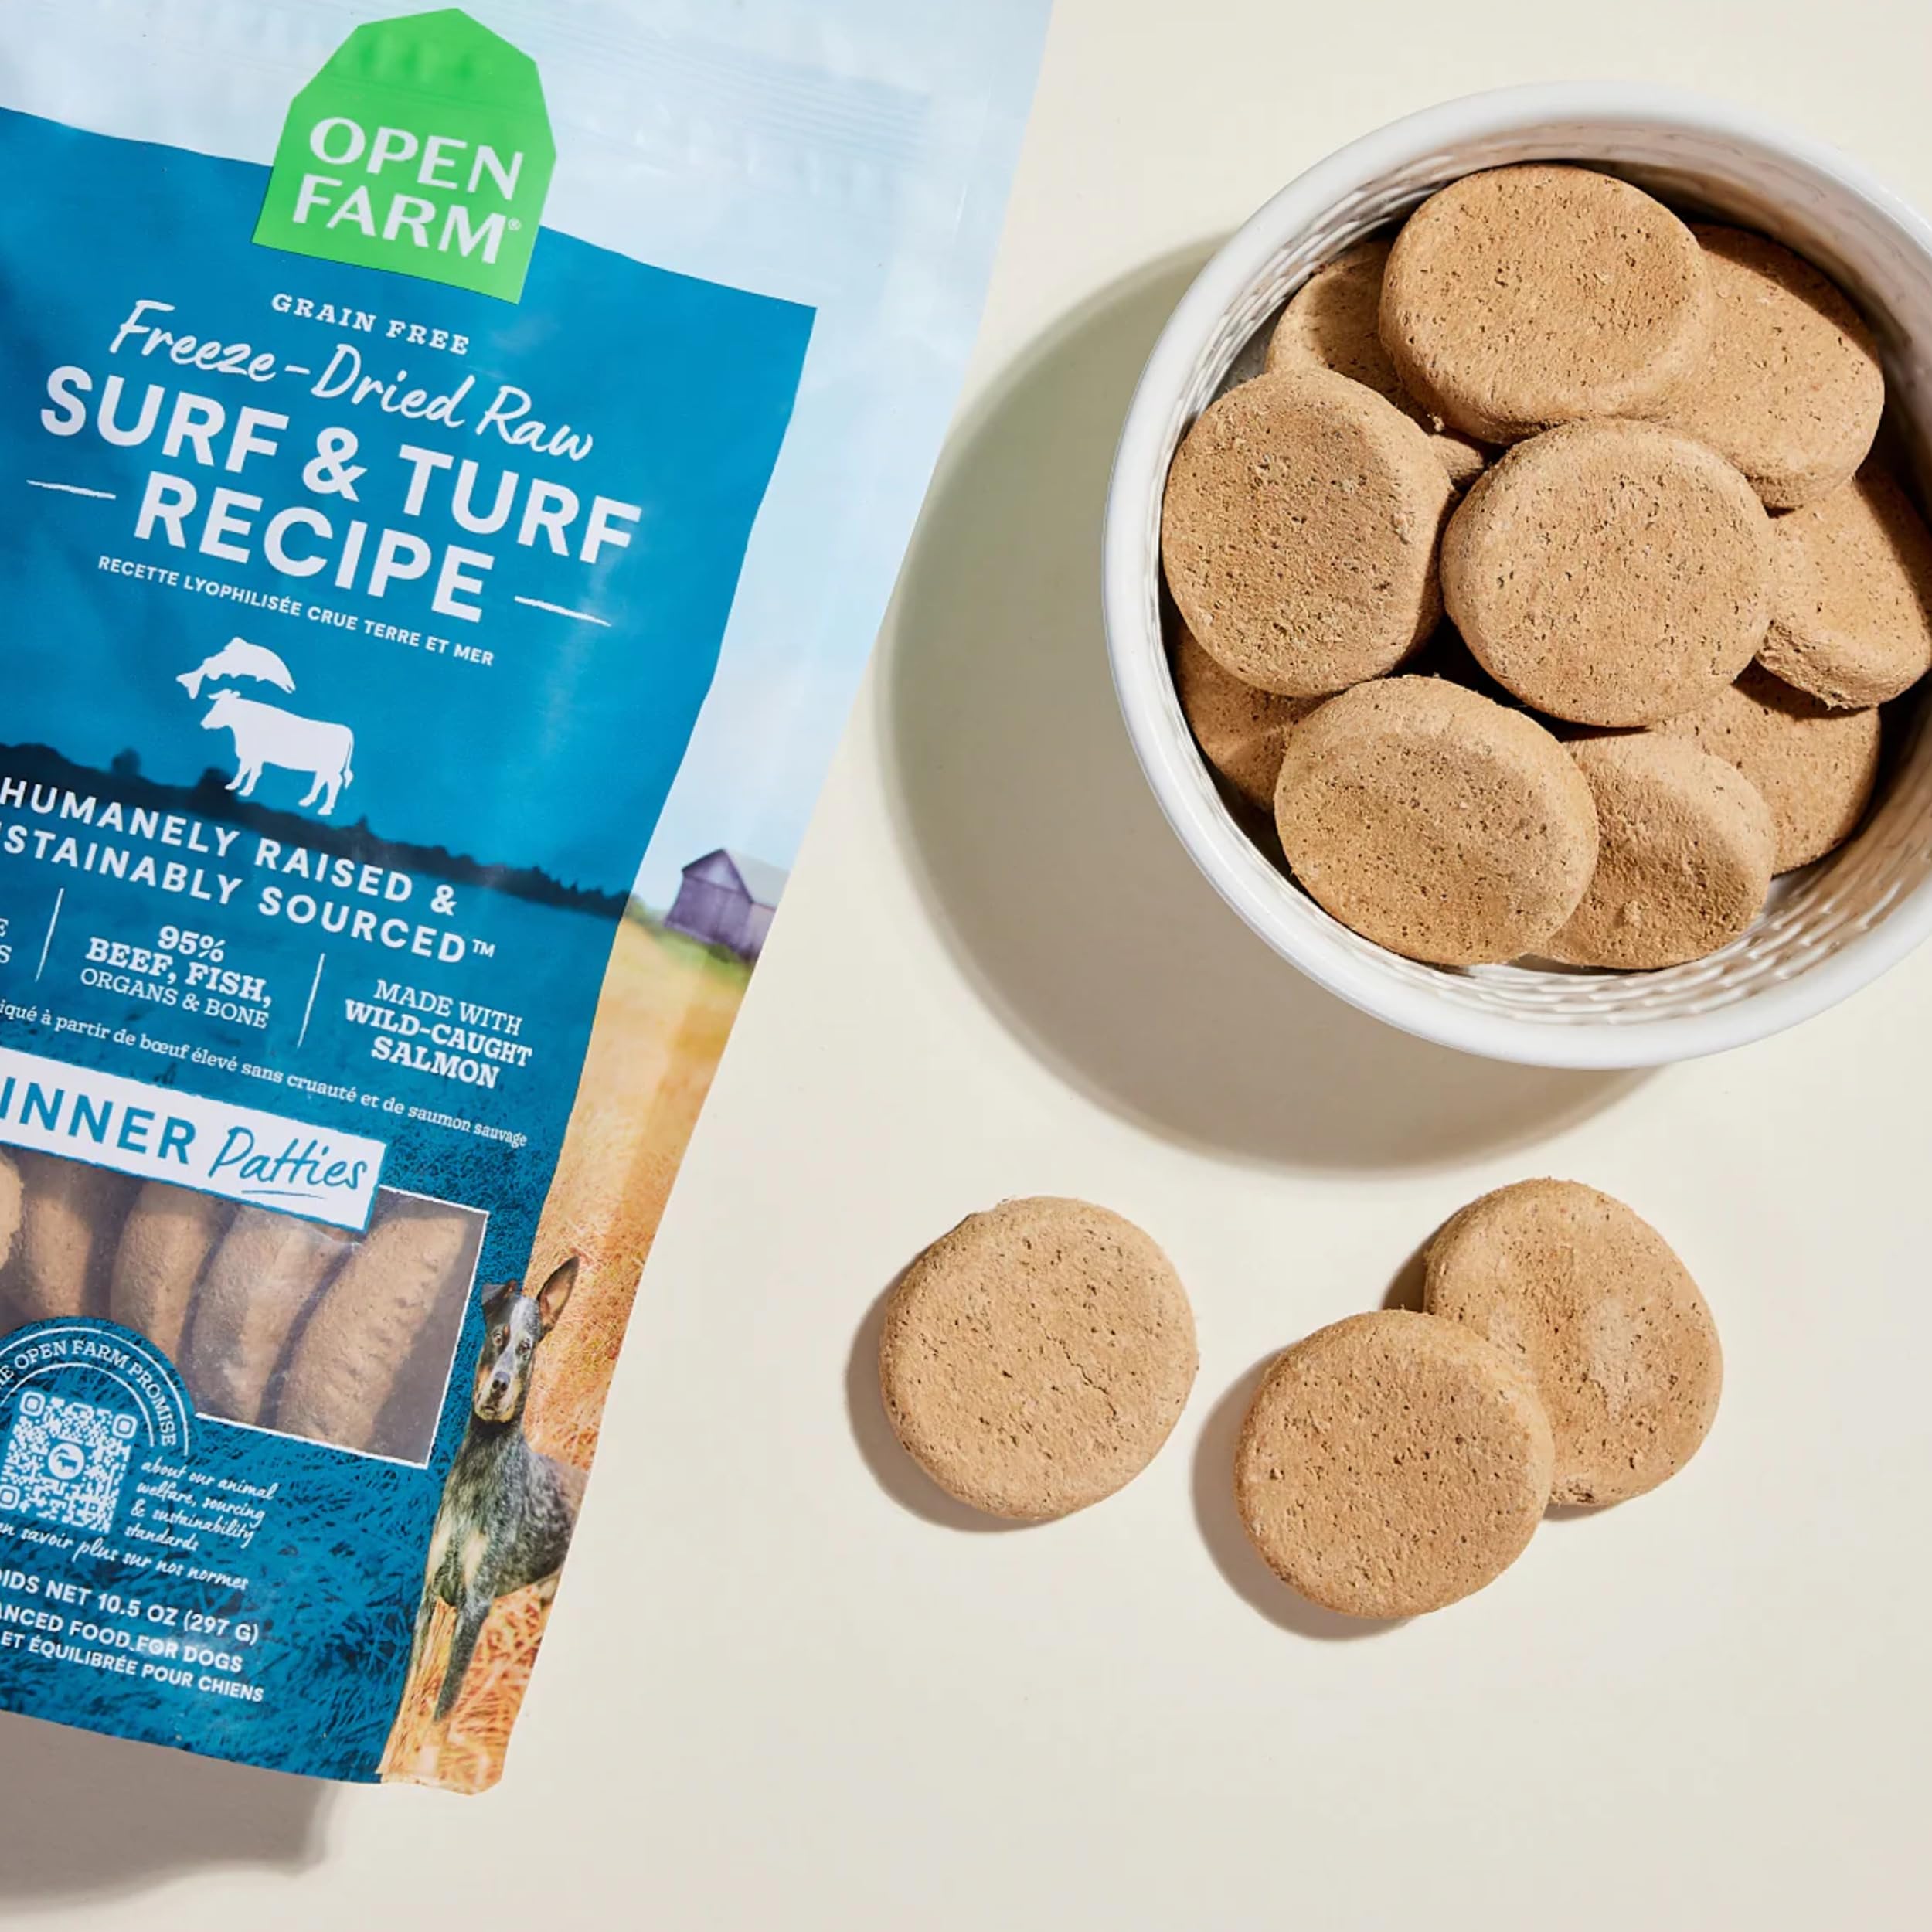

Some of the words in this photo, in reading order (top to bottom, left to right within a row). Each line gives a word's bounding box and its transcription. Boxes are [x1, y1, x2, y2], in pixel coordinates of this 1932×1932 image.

[310, 117, 524, 200] OPEN
[272, 293, 376, 332] GRAIN
[386, 320, 469, 355] FREE
[476, 386, 593, 461] Raw
[41, 365, 289, 474] SURF
[302, 427, 367, 502] &
[399, 444, 641, 563] TURF
[134, 471, 494, 623] RECIPE
[98, 555, 178, 587] RECETTE
[184, 575, 302, 616] LYOPHILISÉE
[307, 607, 358, 631] CRUE
[364, 620, 419, 648] TERRE
[426, 636, 448, 654] ET
[454, 643, 494, 667] MER
[0, 777, 240, 857] HUMANELY
[254, 838, 413, 902] RAISED
[430, 885, 457, 916] &
[0, 821, 242, 904] STAINABLY
[85, 937, 177, 984] BEEF,
[185, 962, 271, 1008] FISH,
[157, 925, 226, 962] 95%
[80, 968, 178, 1005] ORGANS
[182, 994, 200, 1011] &
[204, 998, 269, 1029] BONE
[374, 980, 454, 1018] MADE
[459, 1002, 522, 1036] WITH
[345, 999, 532, 1066] WILD-CAUGHT
[372, 1036, 501, 1089] SALMON
[41, 1009, 51, 1026] à
[55, 1016, 110, 1039] partir
[114, 1029, 136, 1046] de
[191, 1047, 237, 1071] élevé
[241, 1063, 284, 1083] sans
[287, 1075, 356, 1102] cruauté
[361, 1094, 379, 1107] et
[383, 1097, 405, 1114] de
[408, 1106, 471, 1132] saumon
[474, 1123, 527, 1148] sauvage
[209, 1126, 367, 1190] Patties
[14, 1340, 67, 1369] OPEN
[72, 1340, 130, 1369] FARM
[128, 1362, 176, 1446] PROMISE
[137, 1481, 197, 1507] welfare,
[202, 1496, 266, 1527] sourcing
[141, 1457, 186, 1478] about
[189, 1471, 215, 1485] our
[217, 1479, 279, 1500] animal
[124, 1524, 199, 1552] standards
[131, 1499, 146, 1517] &
[152, 1506, 255, 1549] sustainability
[21, 1528, 73, 1549] savoir
[72, 1537, 118, 1563] plus
[122, 1553, 152, 1568] sur
[156, 1560, 182, 1577] nos
[187, 1566, 249, 1590] normes
[45, 1580, 91, 1605] NET
[98, 1594, 141, 1617] 10.5
[147, 1604, 179, 1626] OZ
[183, 1610, 230, 1636] (297
[234, 1624, 260, 1645] G)
[1, 1631, 25, 1648] ET
[28, 1636, 138, 1675] ÉQUILIBRÉE
[141, 1663, 192, 1687] POUR
[198, 1676, 264, 1702] CHIENS
[69, 1621, 130, 1649] FOOD
[135, 1634, 179, 1659] FOR
[183, 1646, 243, 1672] DOGS
